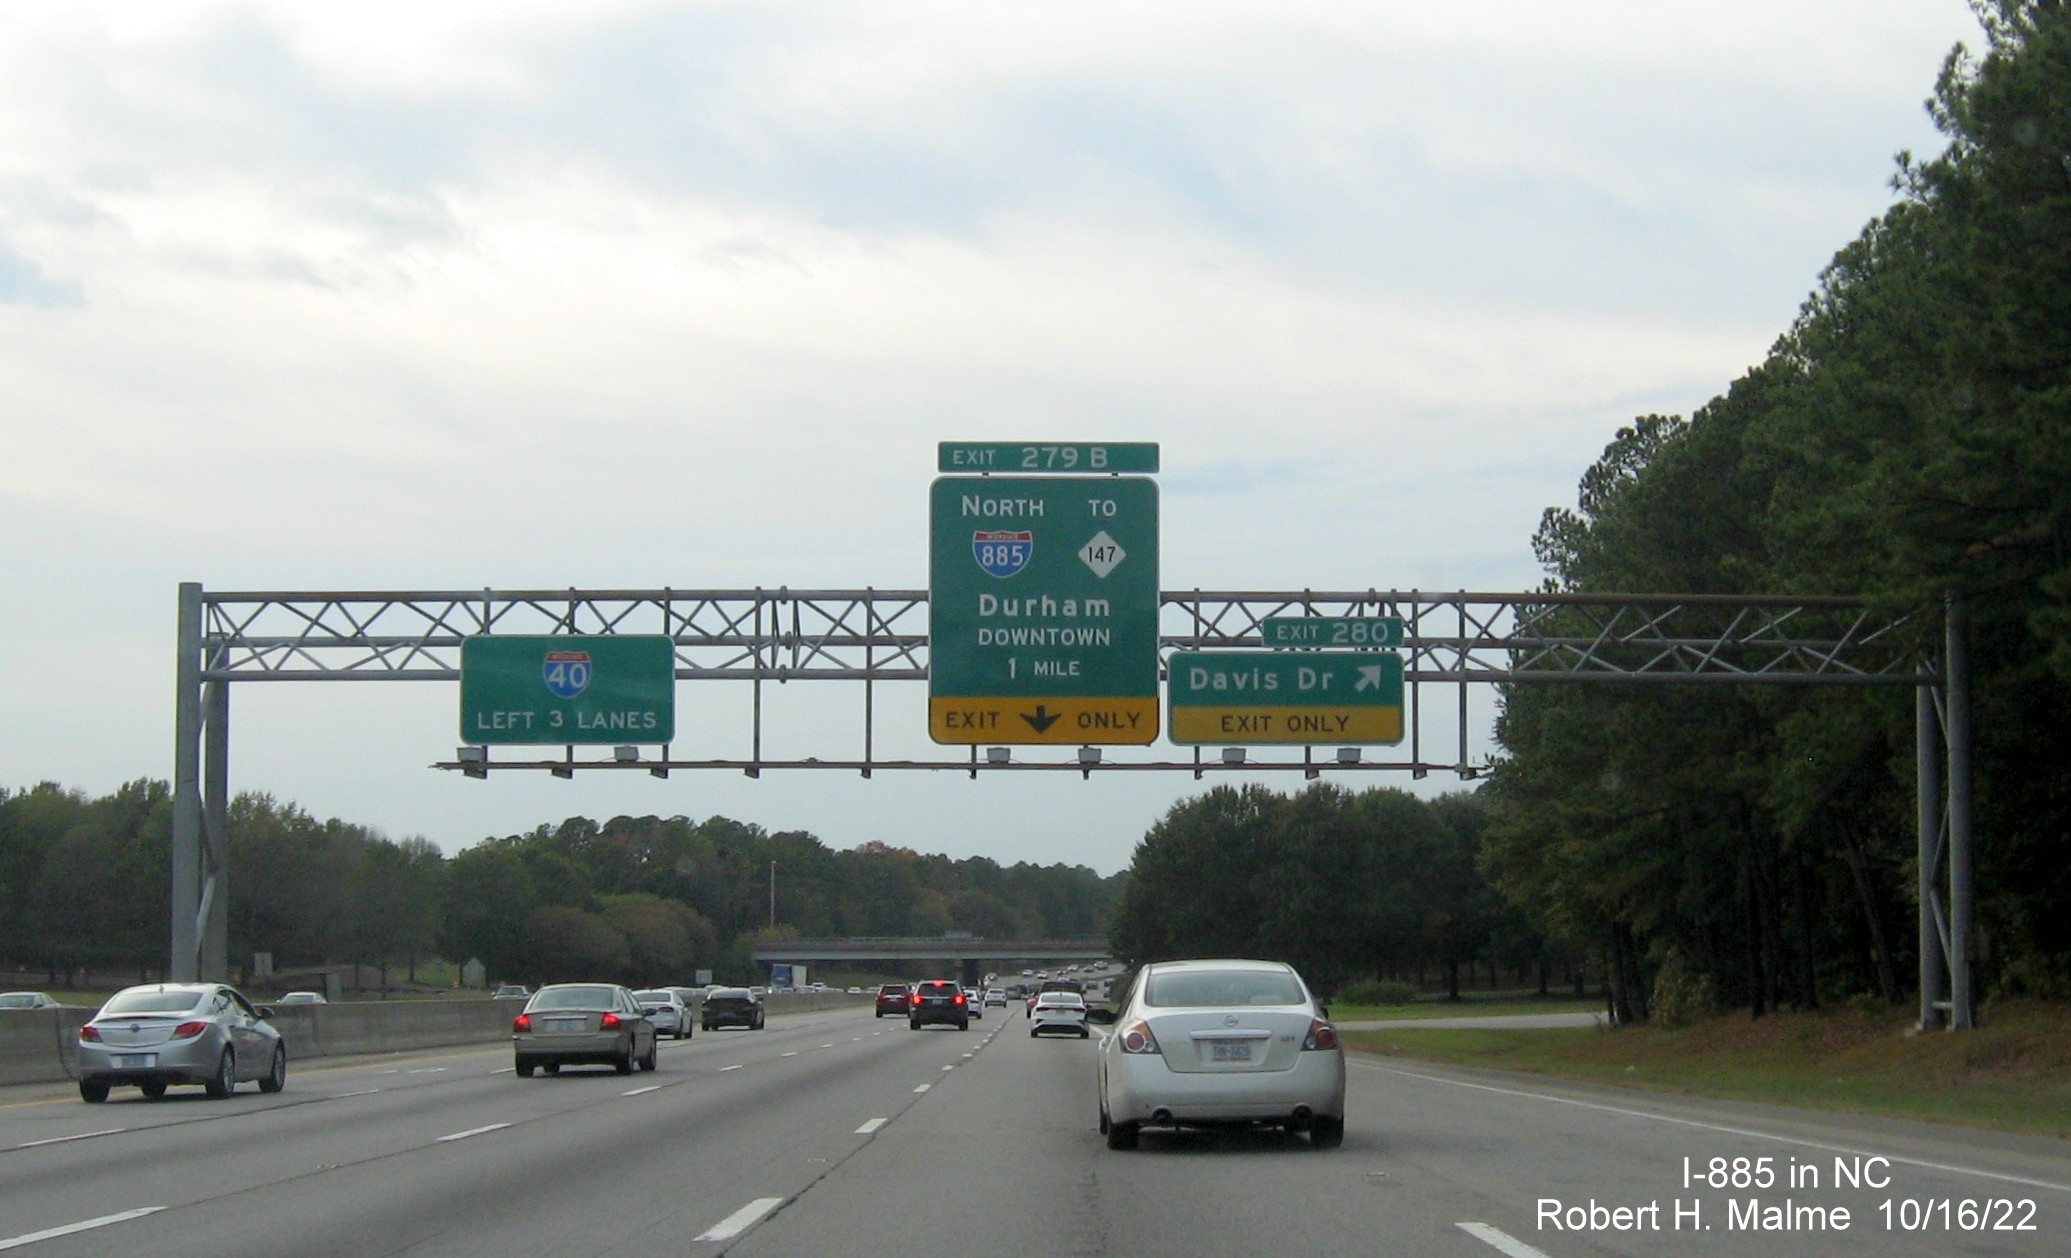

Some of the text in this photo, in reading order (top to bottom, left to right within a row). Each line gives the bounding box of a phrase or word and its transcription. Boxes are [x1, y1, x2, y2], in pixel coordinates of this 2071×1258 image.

[953, 447, 1108, 468] EXIT 279 B
[962, 495, 1117, 517] NORTH TO
[982, 546, 1024, 566] 885
[1088, 546, 1117, 563] 147
[979, 594, 1110, 617] Durham
[978, 628, 1111, 646] DOWNTOWN
[1277, 622, 1389, 643] EXIT 280
[548, 663, 588, 688] 40
[1008, 657, 1080, 679] 1 MILE
[1190, 668, 1333, 690] Davis Dr
[478, 710, 657, 729] LEFT 3 LANES
[946, 711, 1140, 729] EXIT ONLY
[1222, 715, 1350, 733] EXIT ONLY
